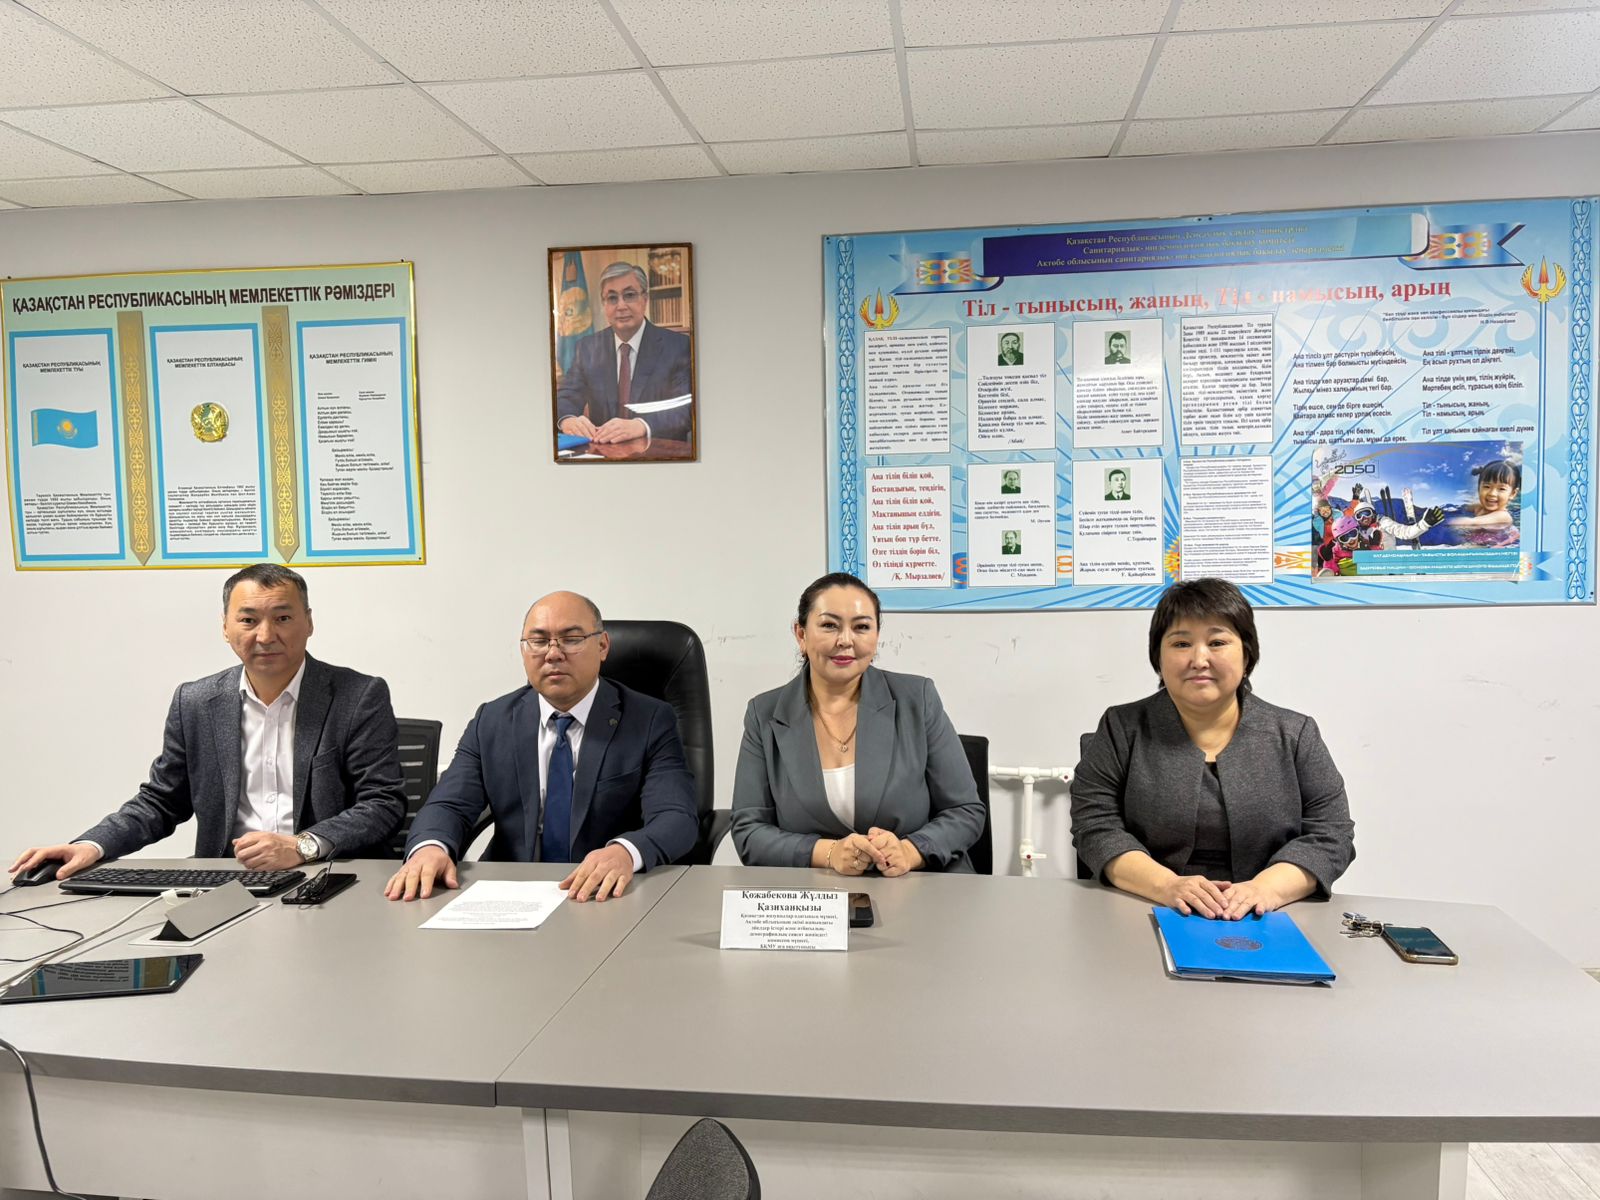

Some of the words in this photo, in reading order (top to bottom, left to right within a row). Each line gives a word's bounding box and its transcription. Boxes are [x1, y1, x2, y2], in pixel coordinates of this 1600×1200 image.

[1066, 236, 1106, 246] Қазақстан
[12, 295, 85, 315] ҚАЗАҚСТАН
[88, 290, 227, 309] РЕСПУБЛИКАСЫНЫҢ
[229, 286, 321, 304] МЕМЛЕКЕТТІК
[325, 282, 395, 301] РӘМІЗДЕРІ
[962, 299, 996, 316] Тіл
[1016, 297, 1124, 314] тынысың,
[1129, 293, 1209, 311] жаның,
[1216, 287, 1252, 306] Тіл
[1272, 285, 1385, 304] намысың,
[1391, 281, 1451, 301] арың
[1334, 464, 1376, 474] 2050
[742, 890, 797, 900] Қожабекова
[799, 891, 838, 901] Жұлдыз
[757, 902, 822, 912] Қазиханқызы
